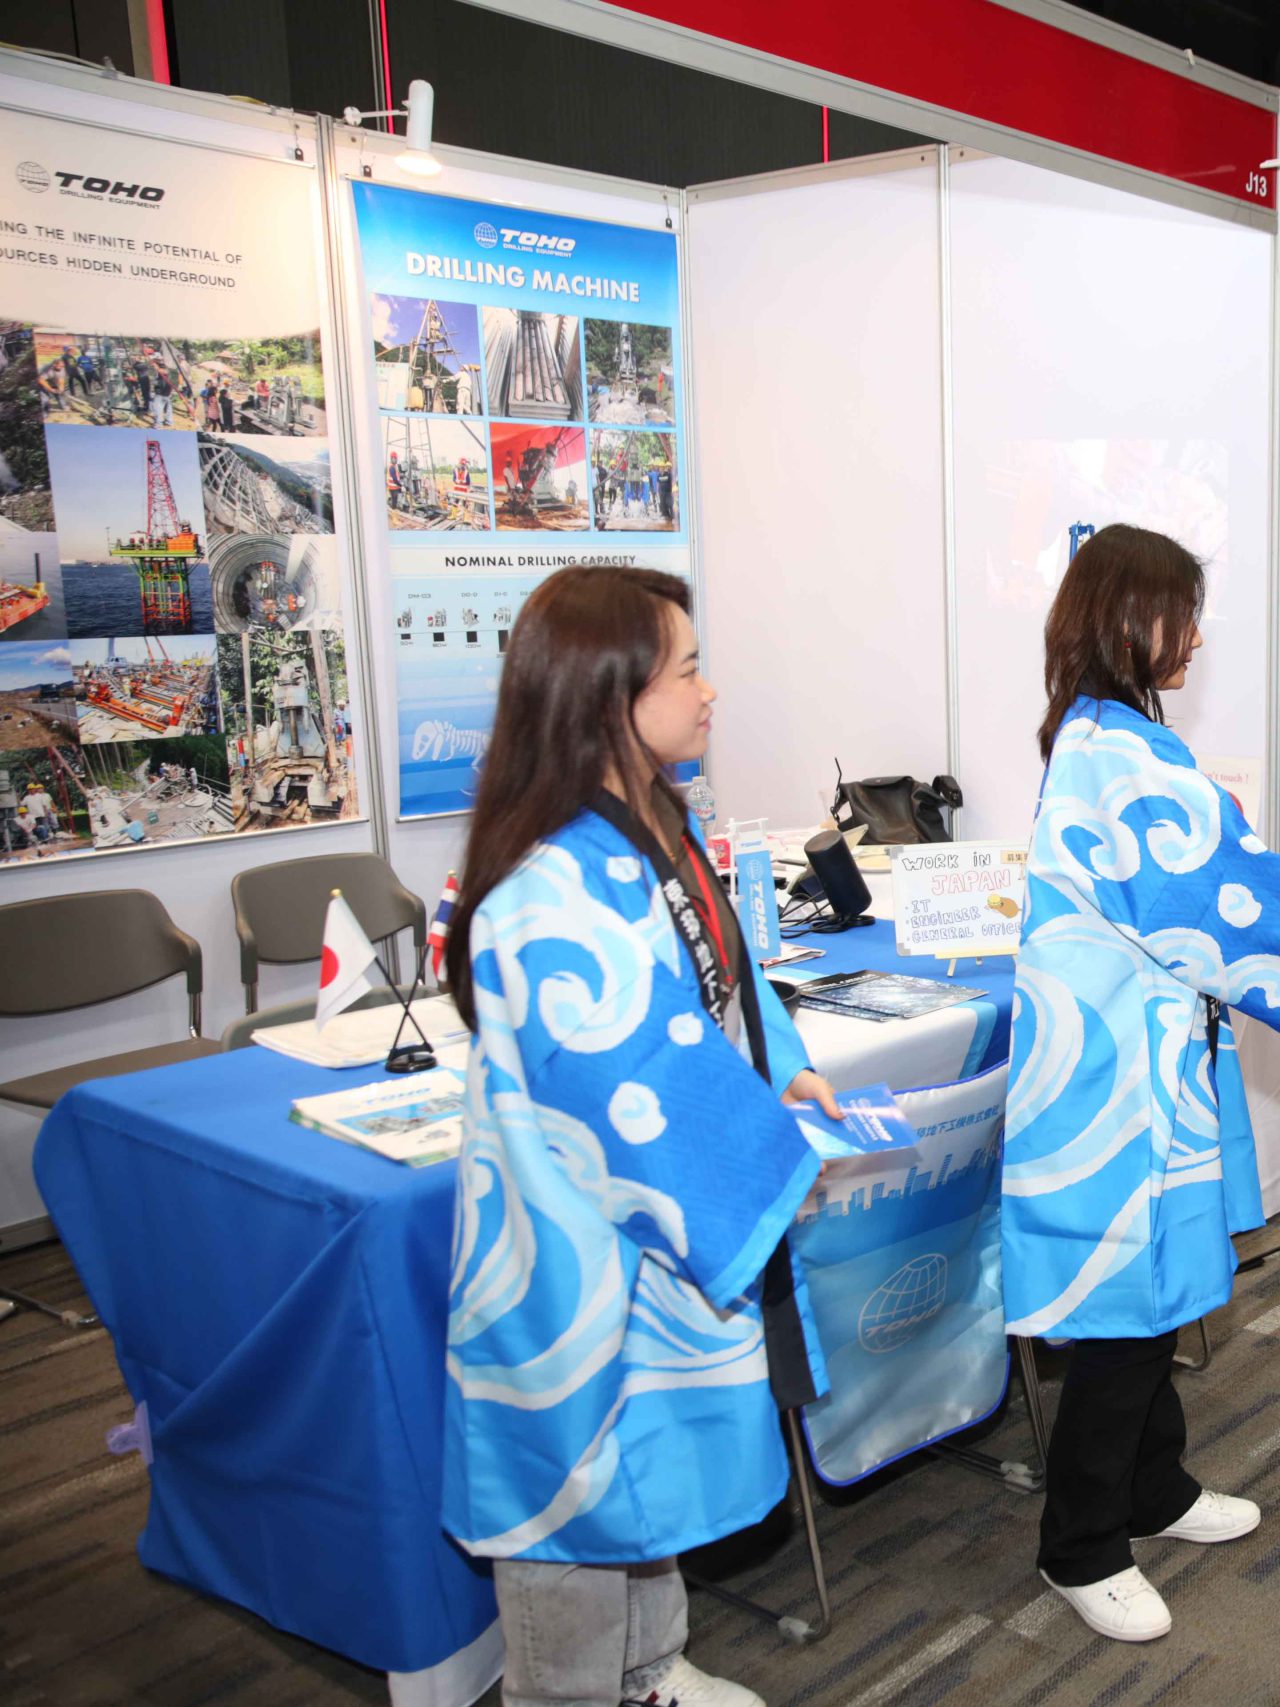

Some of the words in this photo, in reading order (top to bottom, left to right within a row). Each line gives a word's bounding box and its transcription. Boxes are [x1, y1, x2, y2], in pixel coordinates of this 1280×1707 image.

[55, 171, 165, 202] TOHO
[1245, 171, 1267, 197] J13
[59, 188, 104, 201] DRILLING
[108, 197, 161, 210] EQUIPMENT
[34, 224, 65, 241] THE
[73, 231, 136, 251] INFINITE
[143, 241, 220, 262] POTENTIAL
[225, 253, 243, 265] OF
[500, 228, 576, 252] TOHO
[66, 257, 123, 274] HIDDEN
[130, 265, 236, 289] UNDERGROUND
[406, 252, 525, 288] DRILLING
[532, 269, 641, 303] MACHINE
[445, 556, 514, 567] NOMINAL
[518, 556, 577, 566] DRILLING
[580, 555, 636, 566] CAPACITY
[902, 854, 959, 872] WORK
[931, 869, 1011, 896] JAPAN
[754, 881, 769, 949] TOHO
[911, 899, 931, 914] IT
[912, 927, 974, 943] GENERAL
